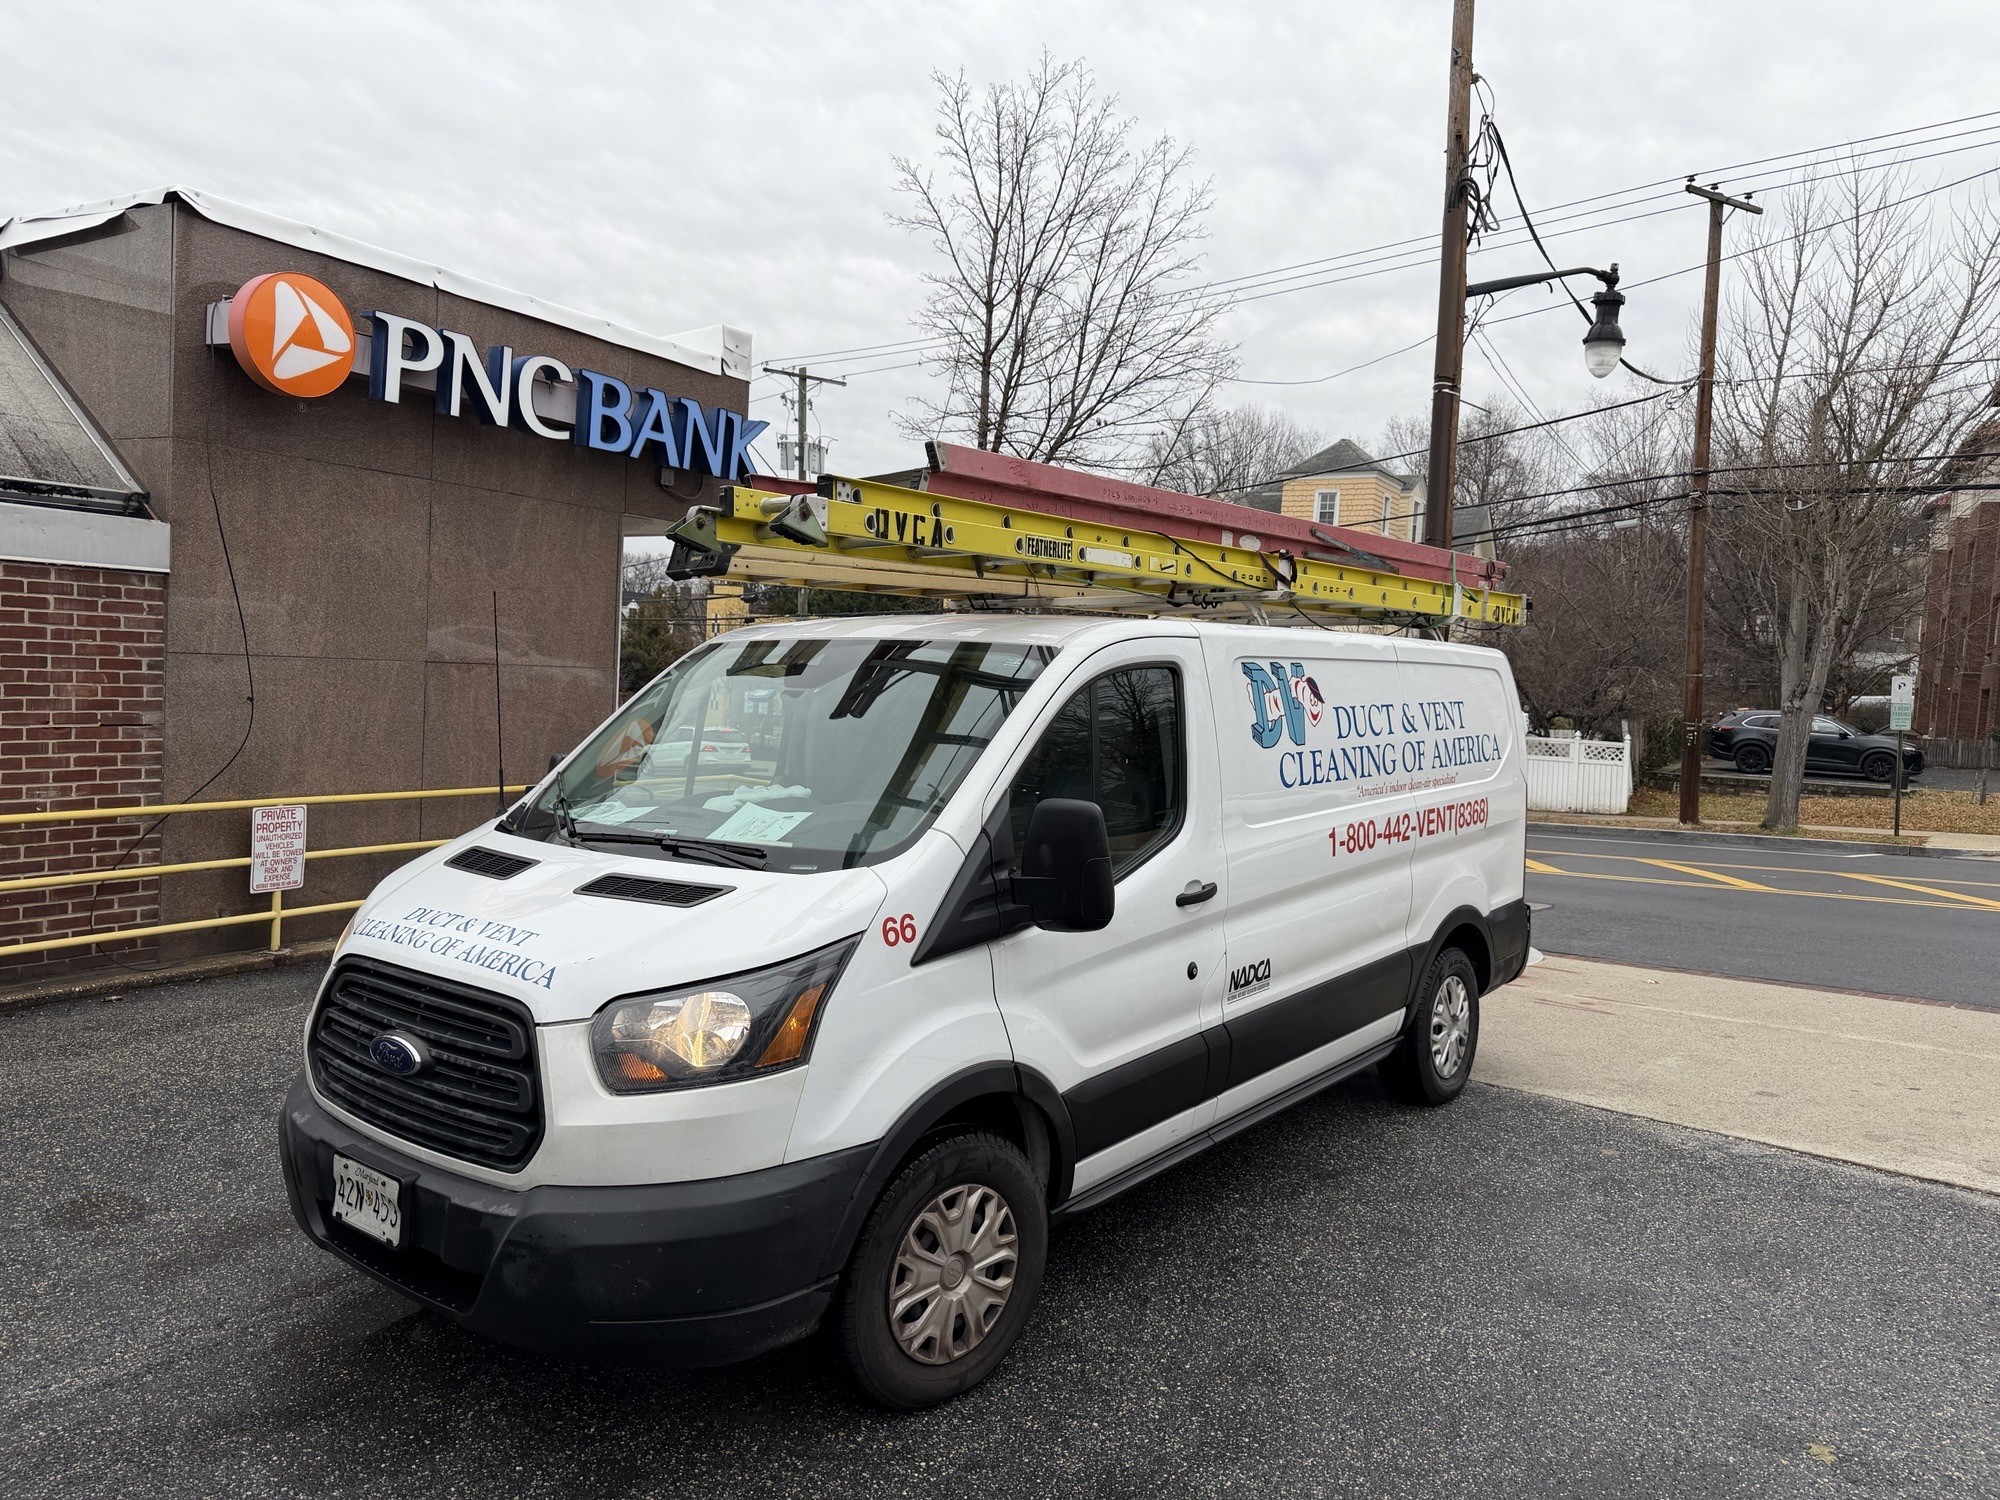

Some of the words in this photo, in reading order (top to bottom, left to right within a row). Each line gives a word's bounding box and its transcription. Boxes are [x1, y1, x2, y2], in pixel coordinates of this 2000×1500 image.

[361, 310, 573, 440] PNC
[576, 368, 770, 480] BANK
[1027, 537, 1071, 560] FEATHERLITE
[1333, 703, 1394, 739] DUCT
[1401, 702, 1418, 733] &
[1418, 701, 1465, 733] VENT
[1279, 743, 1397, 788] CLEANING
[1402, 740, 1425, 773] OF
[1432, 733, 1502, 770] AMERICA
[261, 809, 296, 821] PRIVATE
[256, 821, 302, 834] PROPERTY
[256, 832, 302, 842] UNAUTHORIZED
[1328, 797, 1489, 857] 1-800-442-VENT(8368)
[265, 841, 294, 850] VEHICLES
[272, 850, 280, 858] BE
[283, 849, 304, 857] TOWED
[264, 866, 278, 874] RISK
[270, 857, 297, 866] OWNER'S
[264, 873, 291, 882] EXPENSE
[403, 907, 458, 928] DUCT
[456, 917, 477, 933] &
[478, 921, 540, 947] VENT
[882, 913, 916, 947] 66
[353, 917, 433, 949] CLEANING
[430, 936, 465, 956] OF
[455, 943, 557, 990] AMERICA
[1228, 958, 1271, 993] NADCA
